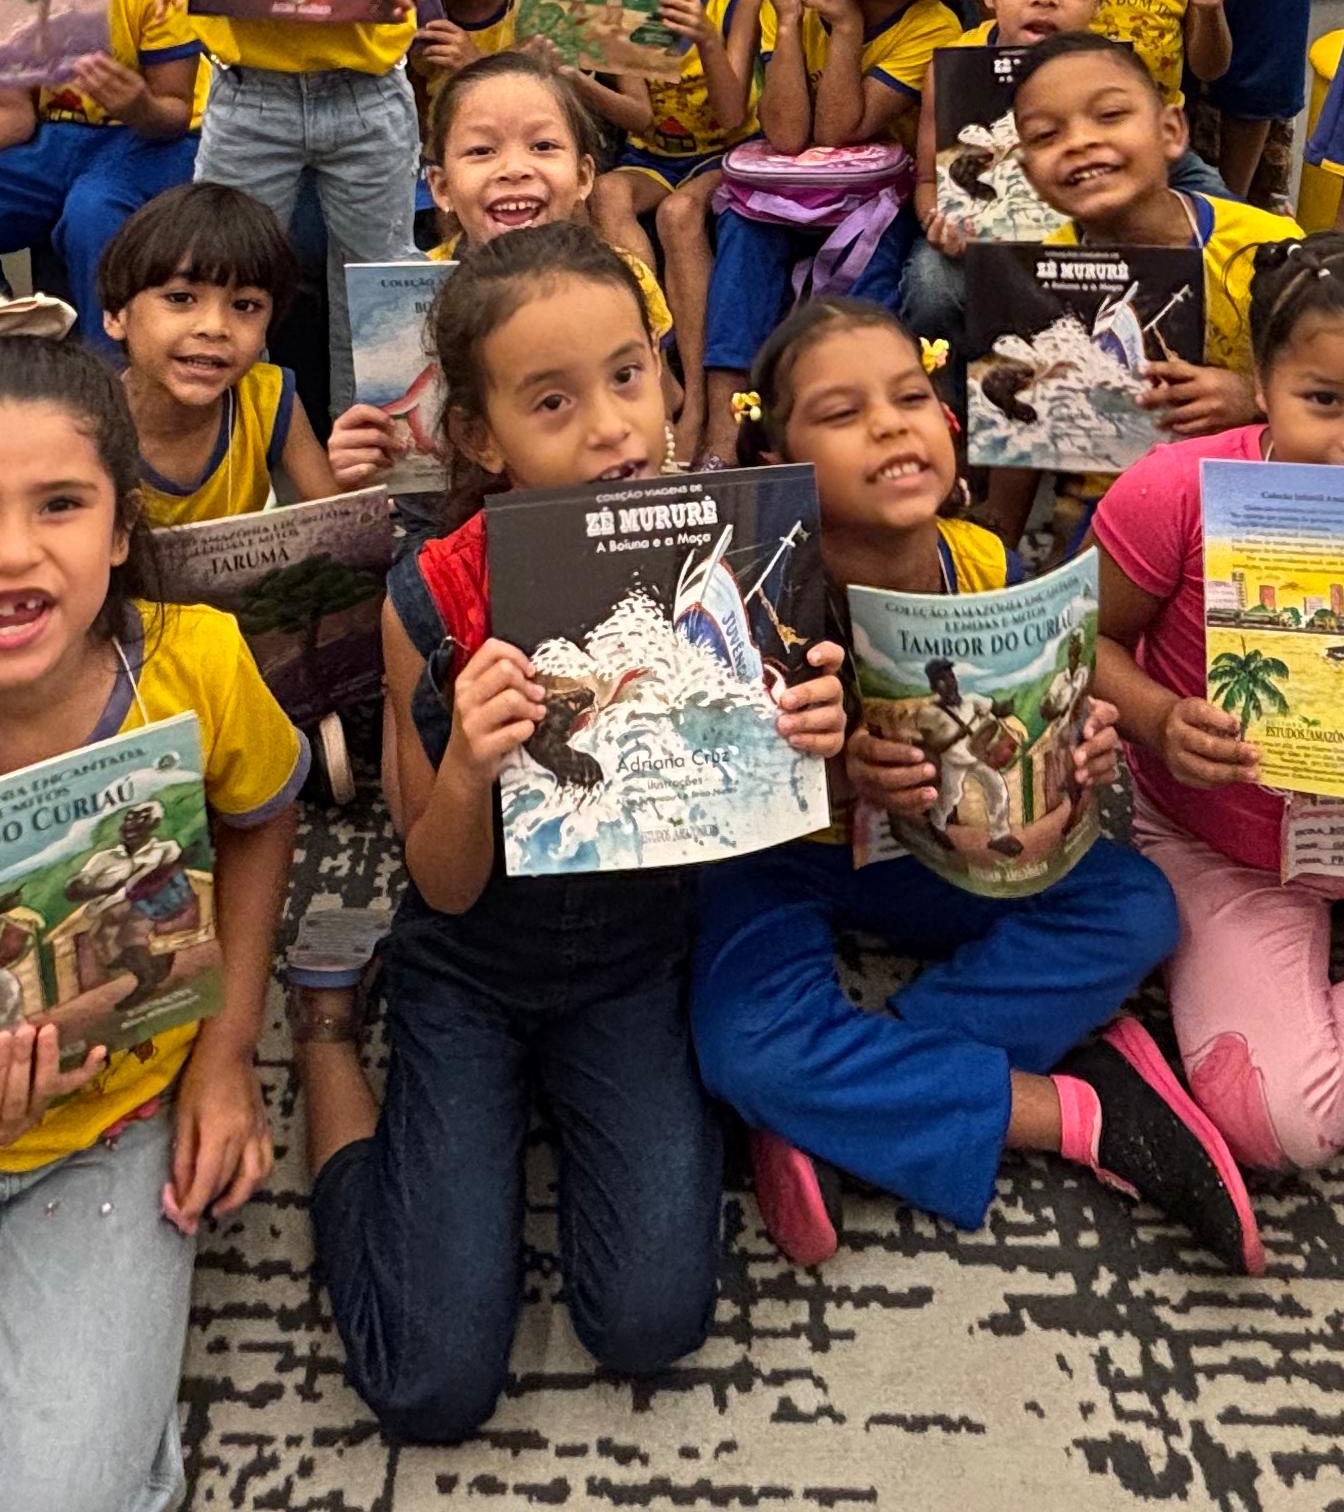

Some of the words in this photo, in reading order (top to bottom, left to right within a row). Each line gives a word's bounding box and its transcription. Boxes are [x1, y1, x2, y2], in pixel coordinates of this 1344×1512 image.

[1036, 258, 1057, 279] ZÉ
[1060, 260, 1129, 280] MURURÉ
[596, 490, 643, 503] COLEÇÃO
[645, 485, 688, 497] VIAGENS
[689, 484, 703, 493] DE
[585, 506, 615, 537] ZÉ
[618, 495, 718, 533] MURURÉ
[596, 542, 606, 553] A
[609, 539, 650, 552] Boiuna
[652, 538, 661, 547] e
[664, 537, 674, 546] a
[677, 532, 711, 546] Moça
[898, 629, 985, 658] TAMBOR
[991, 632, 1019, 655] DO
[1266, 726, 1306, 739] ESTUDOS
[33, 748, 146, 791] ENCANTADA
[616, 755, 685, 773] Adriana
[692, 749, 730, 766] Cruz
[32, 776, 135, 831] CURIAÚ
